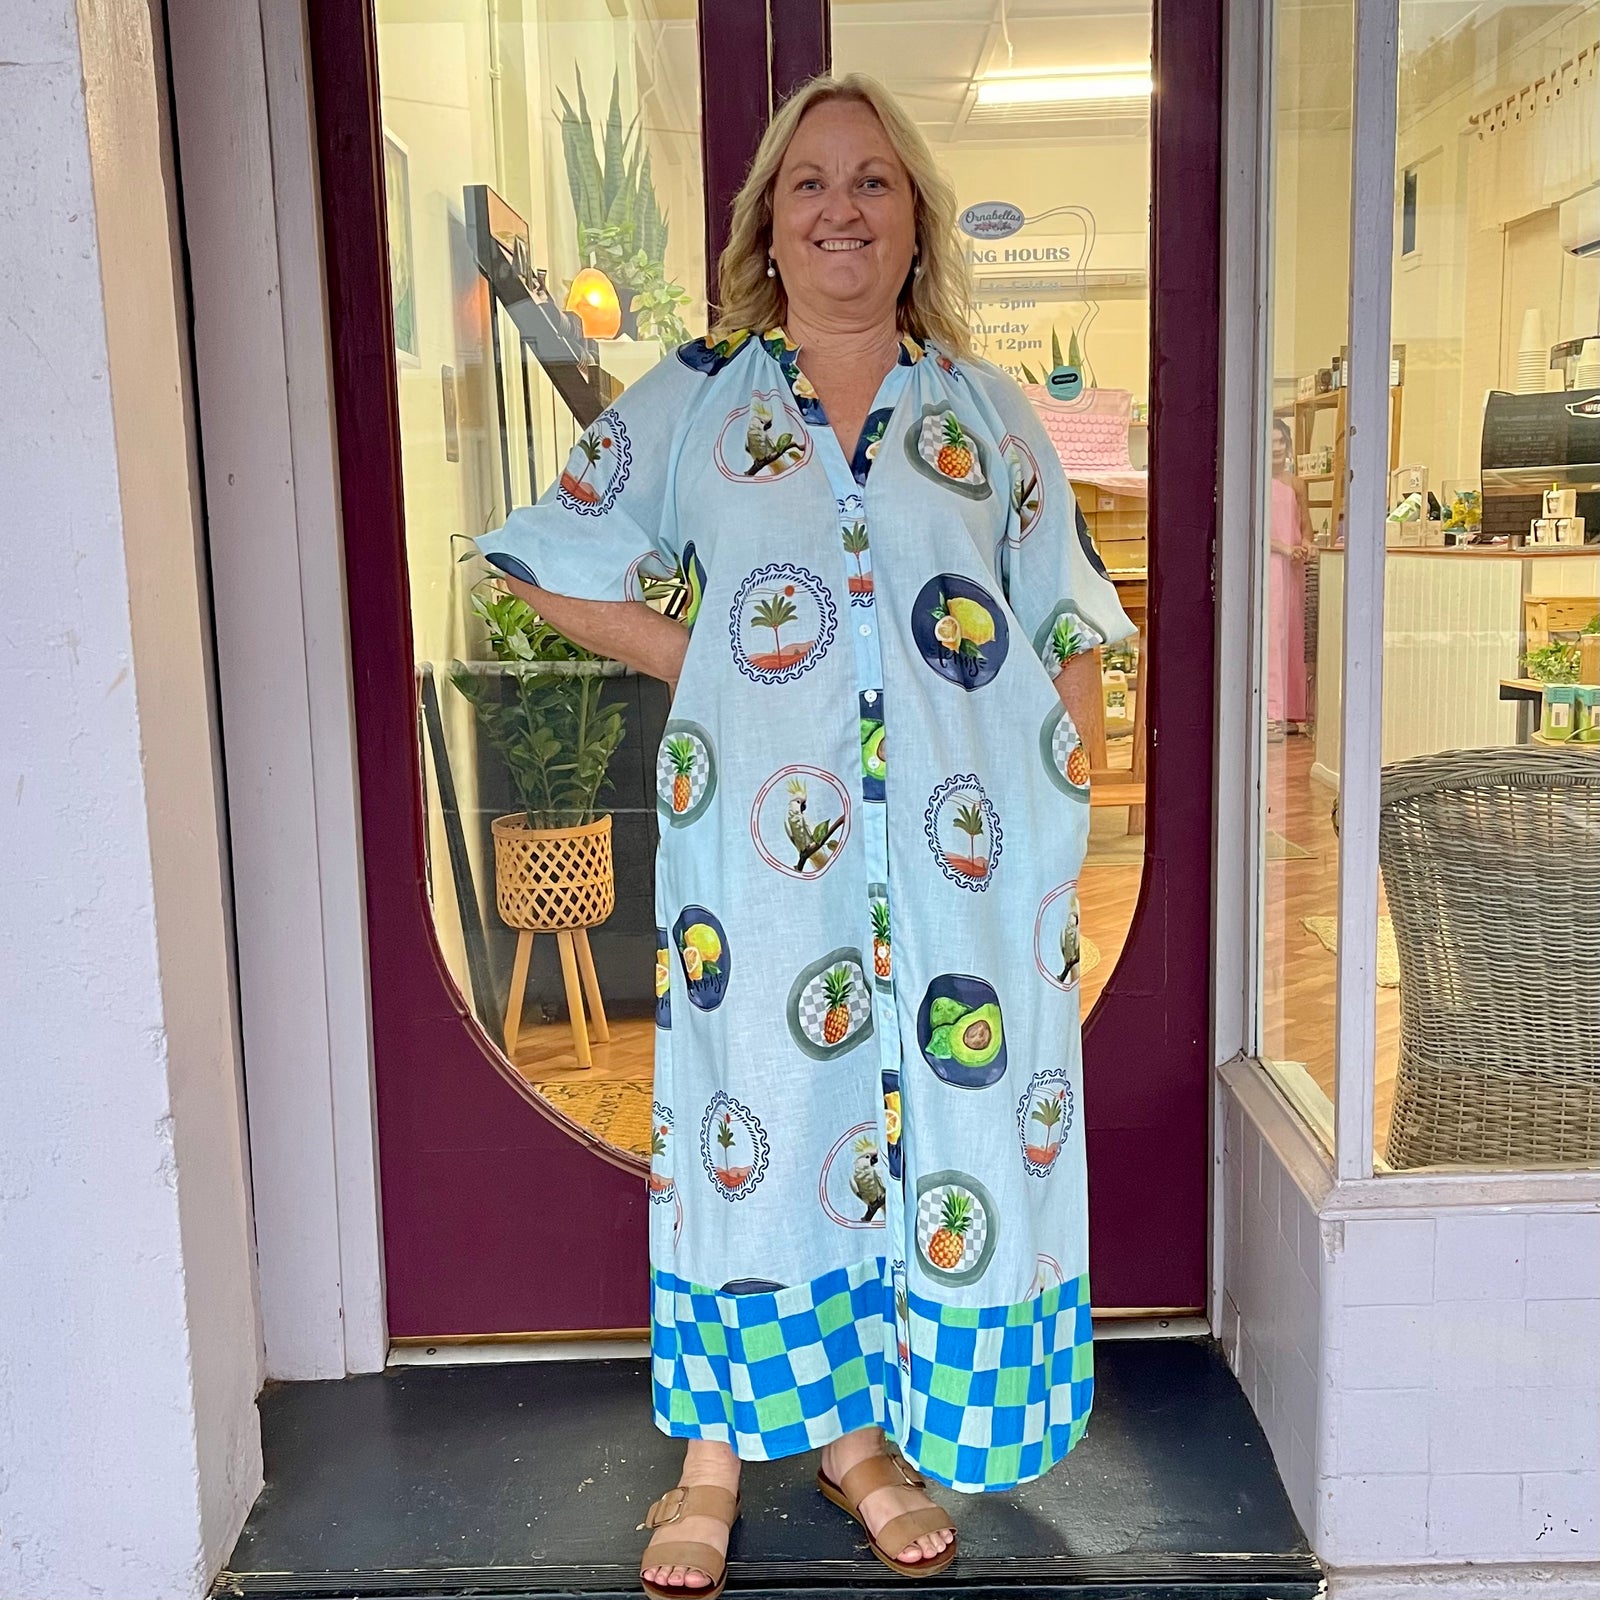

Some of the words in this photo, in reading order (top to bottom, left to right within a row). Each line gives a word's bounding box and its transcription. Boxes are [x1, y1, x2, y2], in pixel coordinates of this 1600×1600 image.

[965, 209, 1021, 224] Ornabellas
[1004, 247, 1070, 262] HOURS
[999, 297, 1037, 311] 5pm
[995, 337, 1043, 352] 12pm
